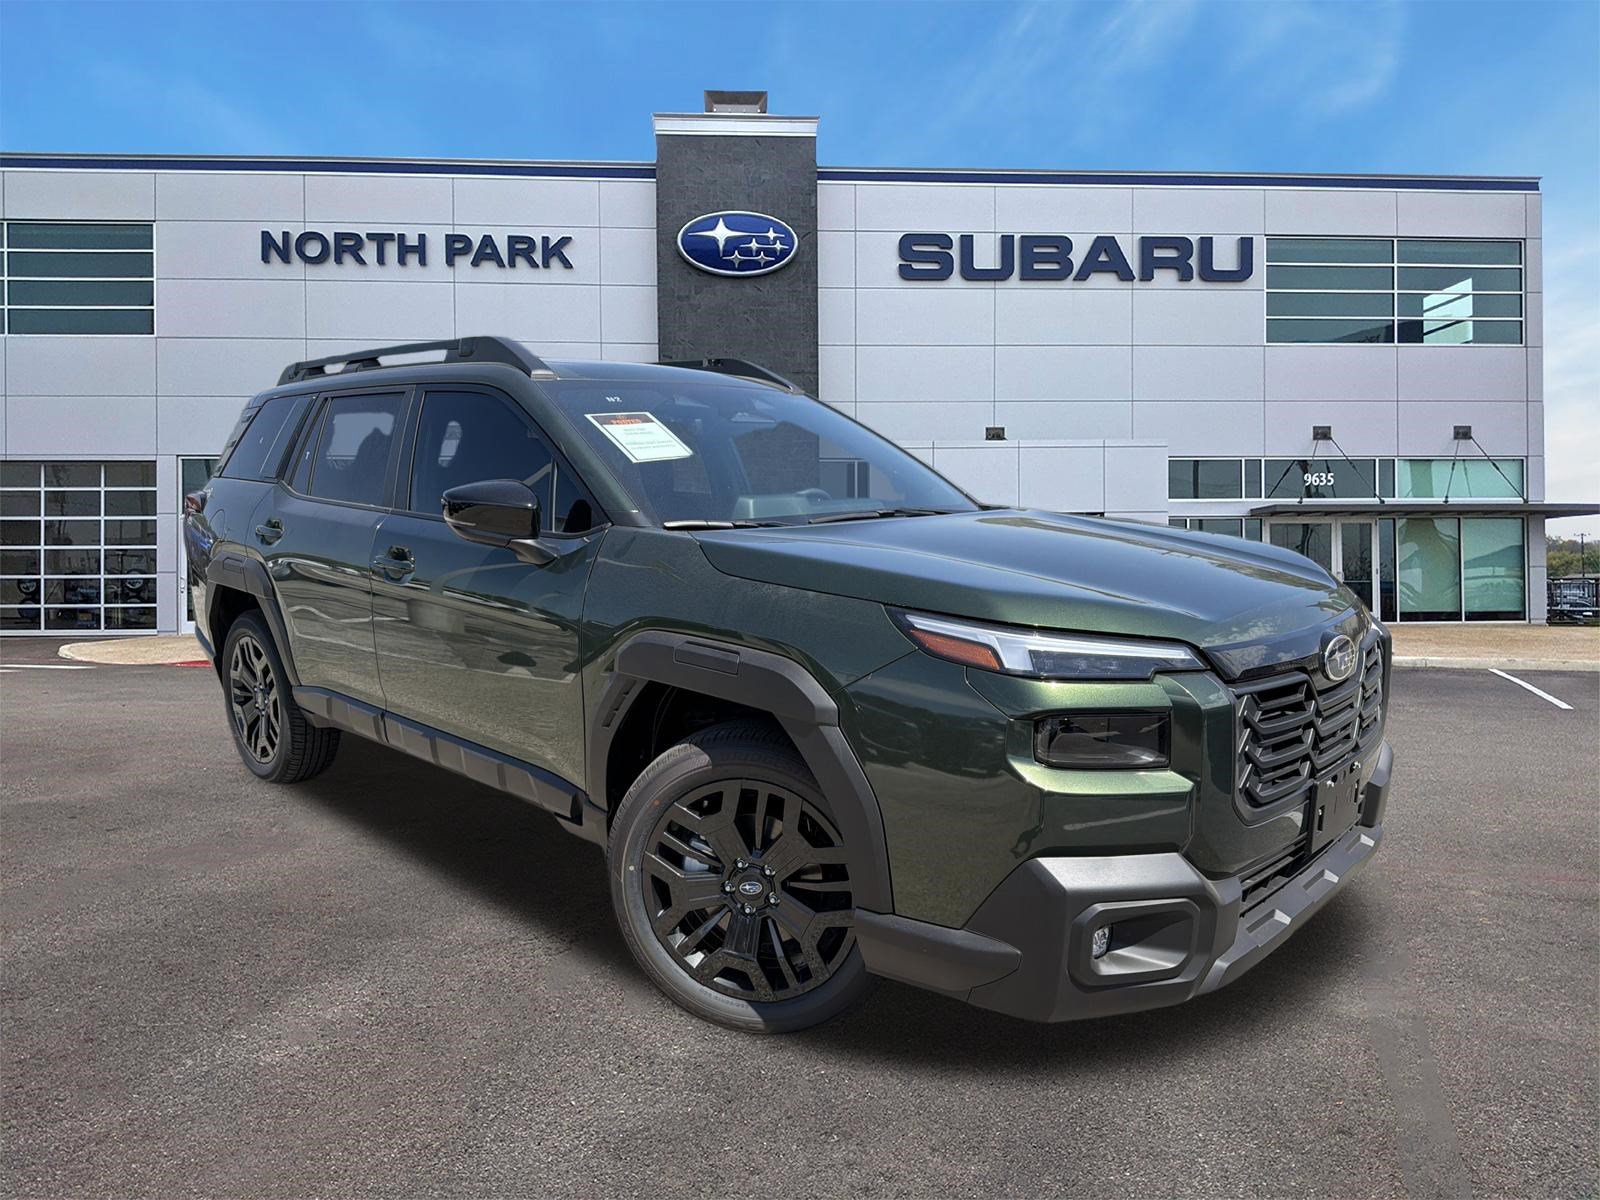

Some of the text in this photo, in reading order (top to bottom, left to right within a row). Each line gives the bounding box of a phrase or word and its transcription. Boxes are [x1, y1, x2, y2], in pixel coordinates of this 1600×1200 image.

[261, 230, 574, 269] NORTH PARK
[898, 232, 1254, 282] SUBARU
[1303, 472, 1335, 486] 9635
